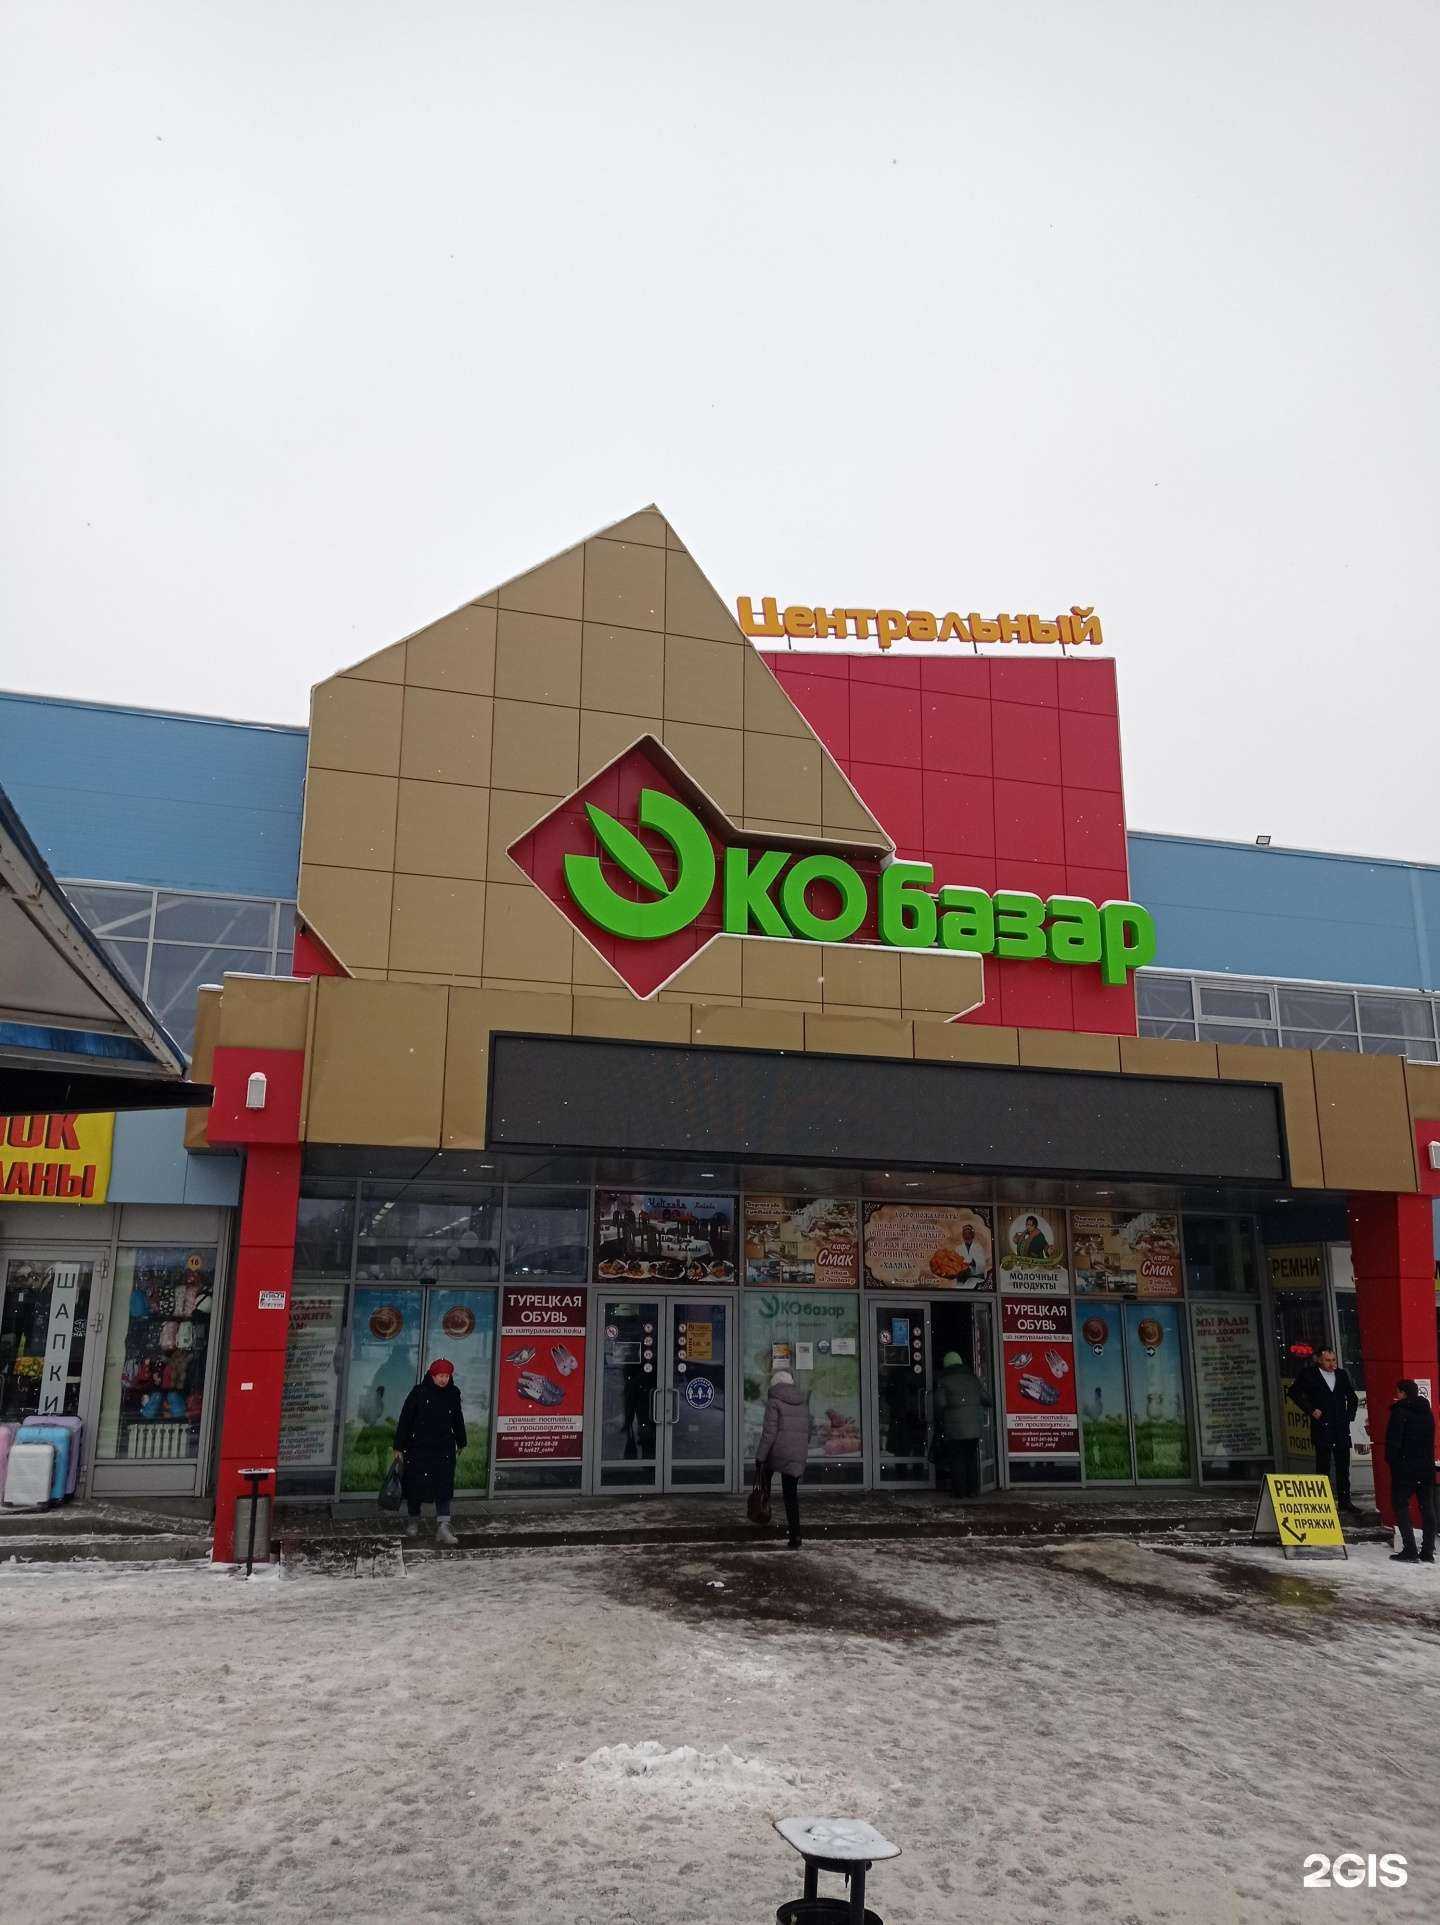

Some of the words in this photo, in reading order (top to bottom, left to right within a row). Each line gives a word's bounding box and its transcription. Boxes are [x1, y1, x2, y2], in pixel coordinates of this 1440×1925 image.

[738, 596, 1102, 649] Центральный
[0, 1161, 96, 1198] АНЫ
[817, 1247, 855, 1267] Смак
[1142, 1260, 1174, 1277] Смак
[1272, 1257, 1320, 1279] РЕМНИ
[1009, 1272, 1059, 1282] МОЛОЧНЫЕ
[1012, 1281, 1057, 1291] ПРОДУКТЫ
[507, 1294, 582, 1308] ТУРЕЦКАЯ
[520, 1311, 568, 1323] ОБУВЬ
[1005, 1304, 1067, 1317] ТУРЕЦКАЯ
[1017, 1319, 1057, 1331] ОБУВЬ
[44, 1272, 76, 1413] ШАПКИ
[1274, 1480, 1328, 1498] РЕМНИ
[1279, 1503, 1332, 1515] ПОДТЯЖКИ
[1294, 1518, 1336, 1529] ПРЯЖКИ
